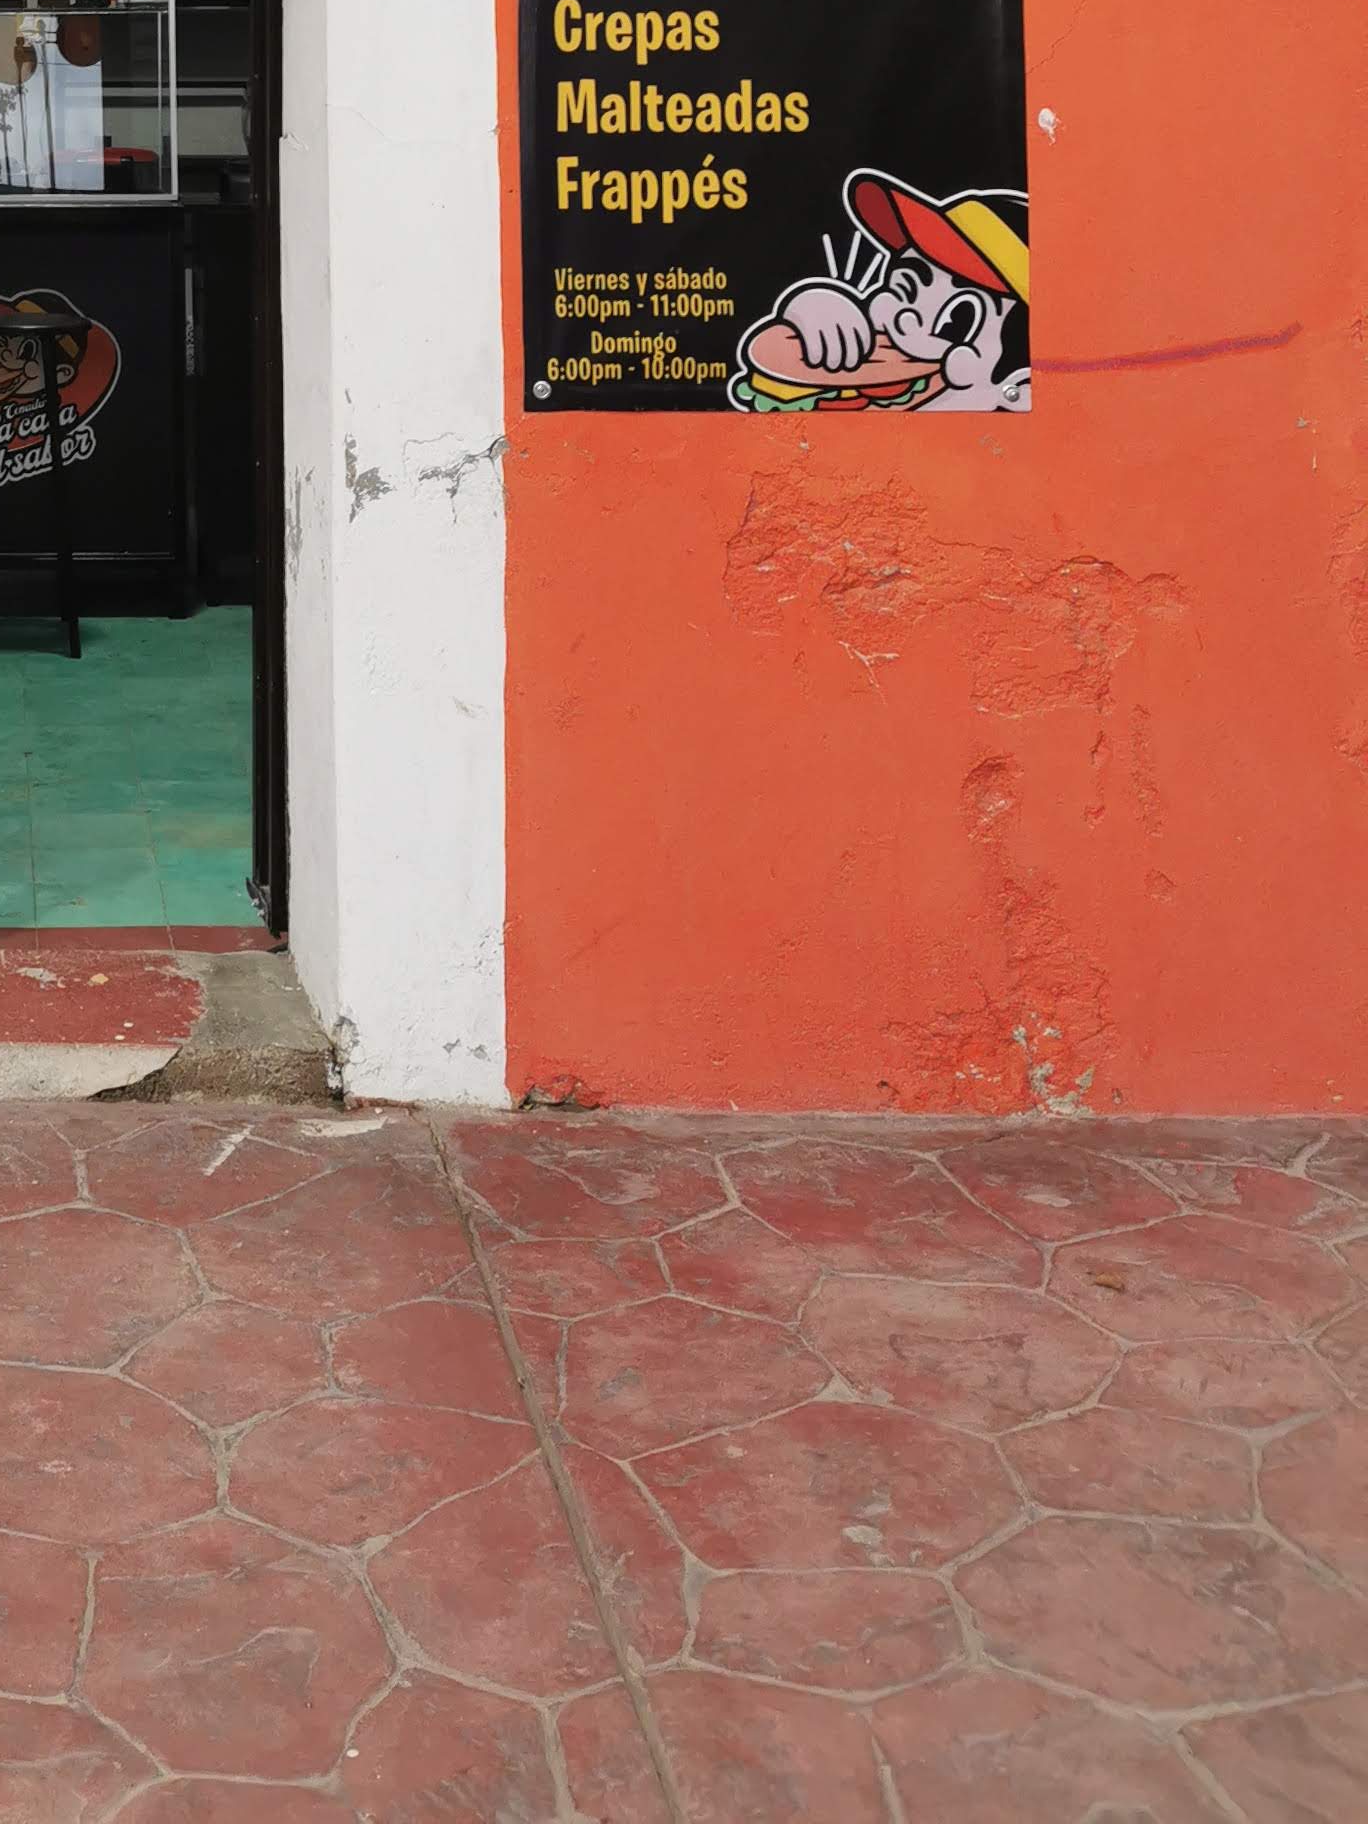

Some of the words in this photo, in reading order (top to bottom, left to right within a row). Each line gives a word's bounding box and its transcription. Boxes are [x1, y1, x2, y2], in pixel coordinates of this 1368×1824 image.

[556, 78, 810, 135] Malteadas
[556, 153, 748, 225] Frappés
[554, 267, 630, 292] Viernes
[636, 272, 648, 297] y
[653, 266, 727, 290] sábado
[554, 294, 631, 323] 6:00pm
[650, 293, 734, 322] 11:00pm
[591, 330, 677, 360] Domingo
[547, 357, 622, 386] 6:00pm
[641, 356, 727, 385] 10:00pm
[18, 405, 78, 436] caa
